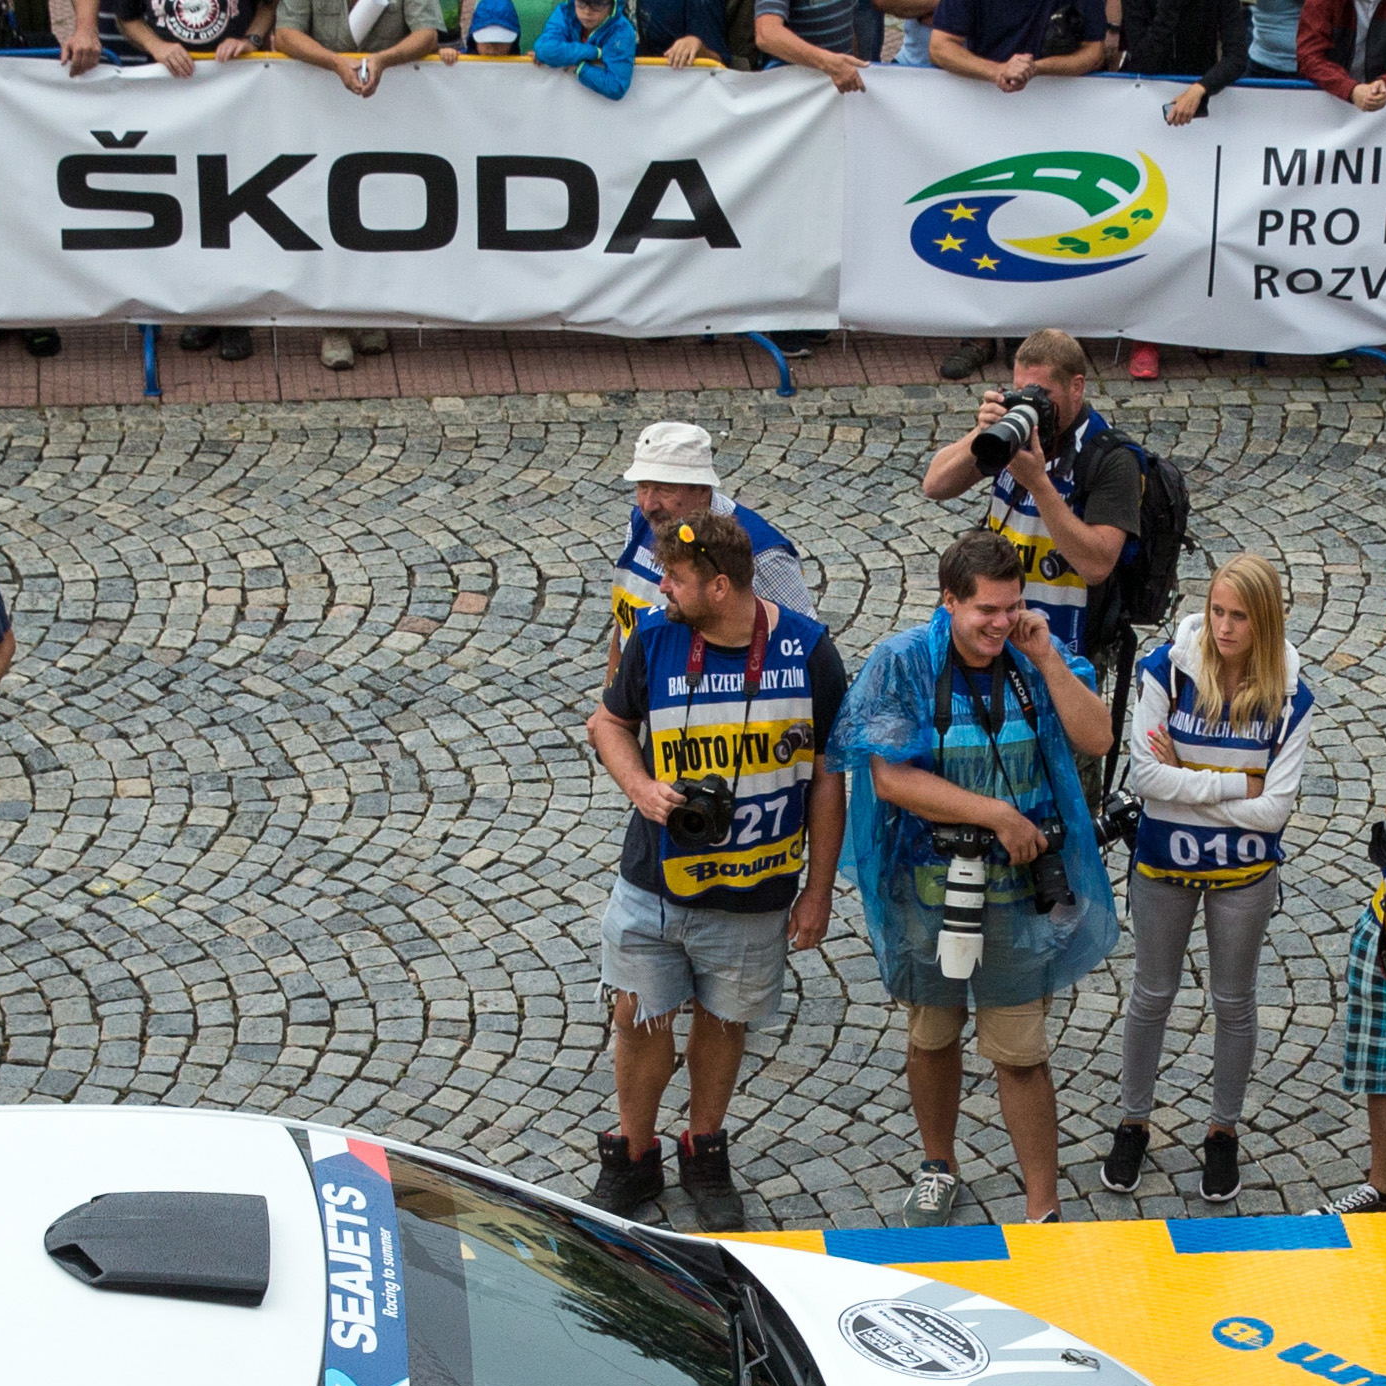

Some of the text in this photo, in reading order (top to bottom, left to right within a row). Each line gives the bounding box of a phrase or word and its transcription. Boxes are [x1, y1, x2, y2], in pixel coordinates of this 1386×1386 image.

[57, 129, 741, 254] ŠKODA
[1257, 208, 1360, 247] PRO
[711, 666, 804, 693] CZECH ZLÍN
[709, 795, 788, 847] 27
[684, 851, 787, 882] Barum
[1169, 830, 1266, 866] 010
[322, 1182, 378, 1353] SEAJETS
[380, 1227, 402, 1319] Racing to summer
